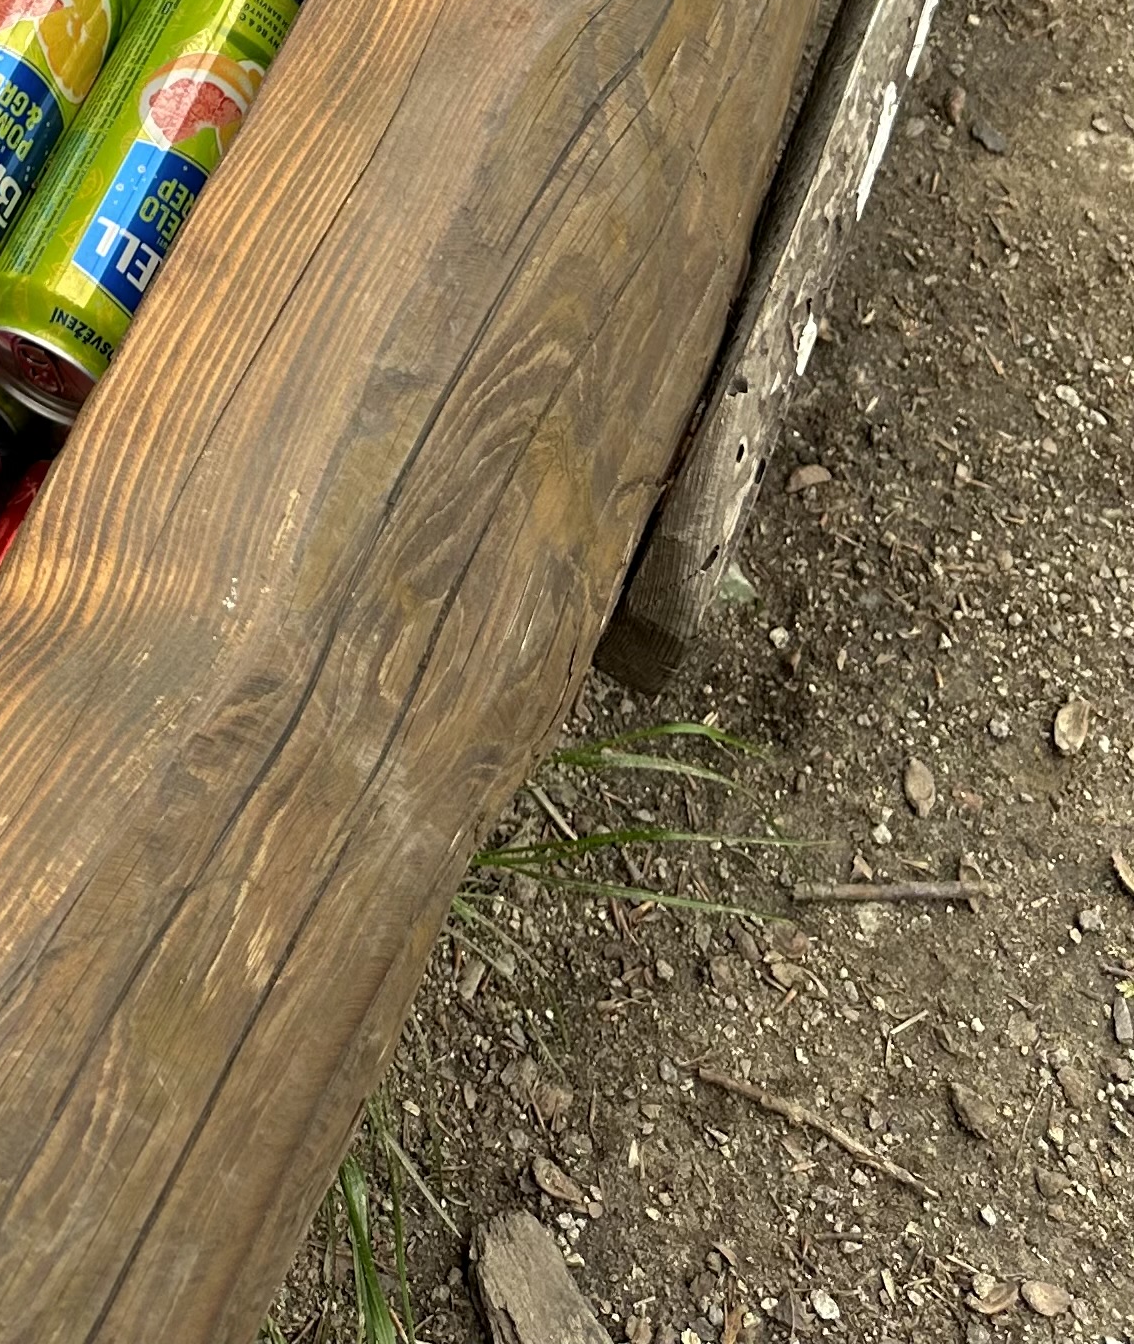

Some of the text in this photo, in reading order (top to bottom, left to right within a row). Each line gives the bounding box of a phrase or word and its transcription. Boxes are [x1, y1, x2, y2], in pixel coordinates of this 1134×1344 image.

[139, 195, 182, 244] ELO
[157, 176, 196, 218] REP
[94, 215, 163, 293] ELL
